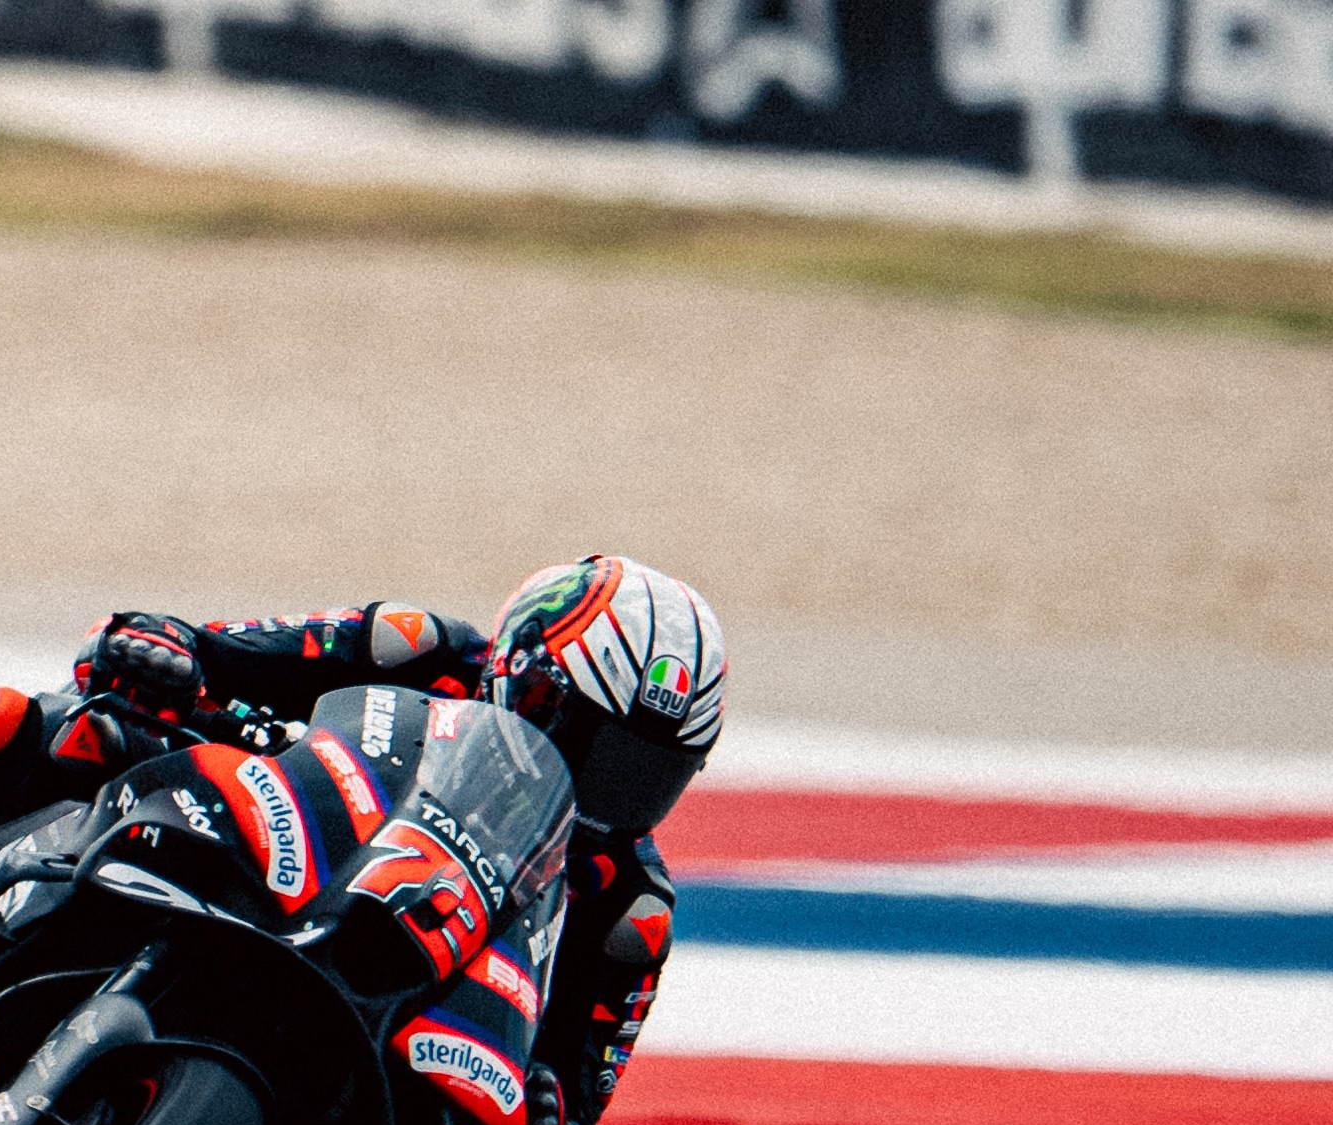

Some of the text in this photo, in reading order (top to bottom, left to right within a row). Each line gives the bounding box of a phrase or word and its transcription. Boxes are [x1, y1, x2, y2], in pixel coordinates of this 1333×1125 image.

[646, 683, 685, 711] agv
[172, 789, 221, 840] sky
[245, 764, 303, 887] sterilgarda
[420, 802, 505, 911] TARGA
[415, 1038, 517, 1106] sterilgarda
